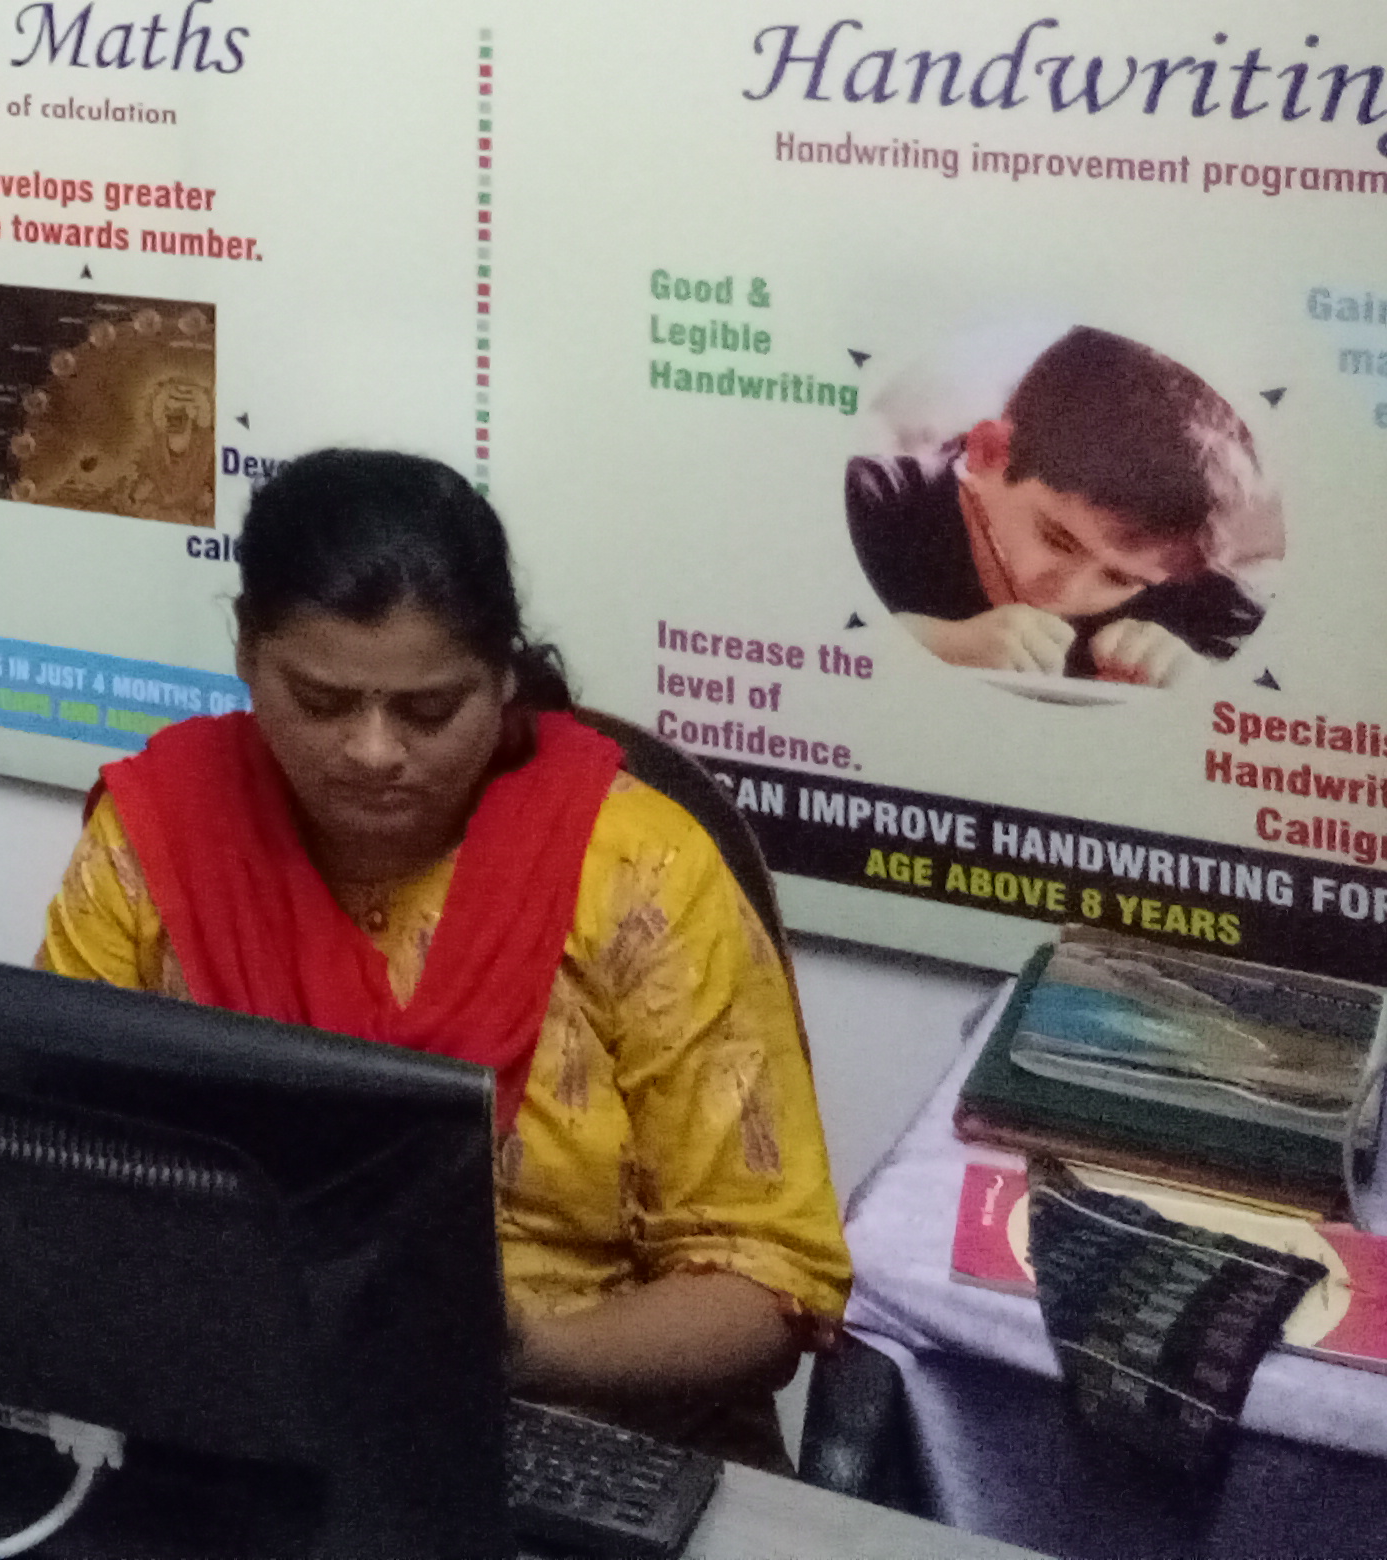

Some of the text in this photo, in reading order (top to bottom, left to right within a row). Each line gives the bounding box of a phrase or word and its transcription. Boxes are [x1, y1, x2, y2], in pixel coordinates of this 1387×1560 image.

[7, 94, 31, 116] of
[42, 97, 176, 124] calculation
[743, 18, 1387, 166] Handwritin
[776, 132, 1190, 183] Handwriting improvement
[105, 182, 215, 211] greater
[12, 215, 129, 250] towards
[142, 228, 262, 261] number.
[651, 269, 770, 308] Good &
[651, 315, 771, 355] Legible
[651, 361, 859, 416] Handwriting
[659, 620, 873, 679] Increase the
[658, 665, 781, 711] level of
[659, 712, 863, 766] Confidence.
[800, 788, 1294, 906] IMPROVE HANDWRITING
[866, 849, 1240, 944] AGE ABOVE 8 YEARS
